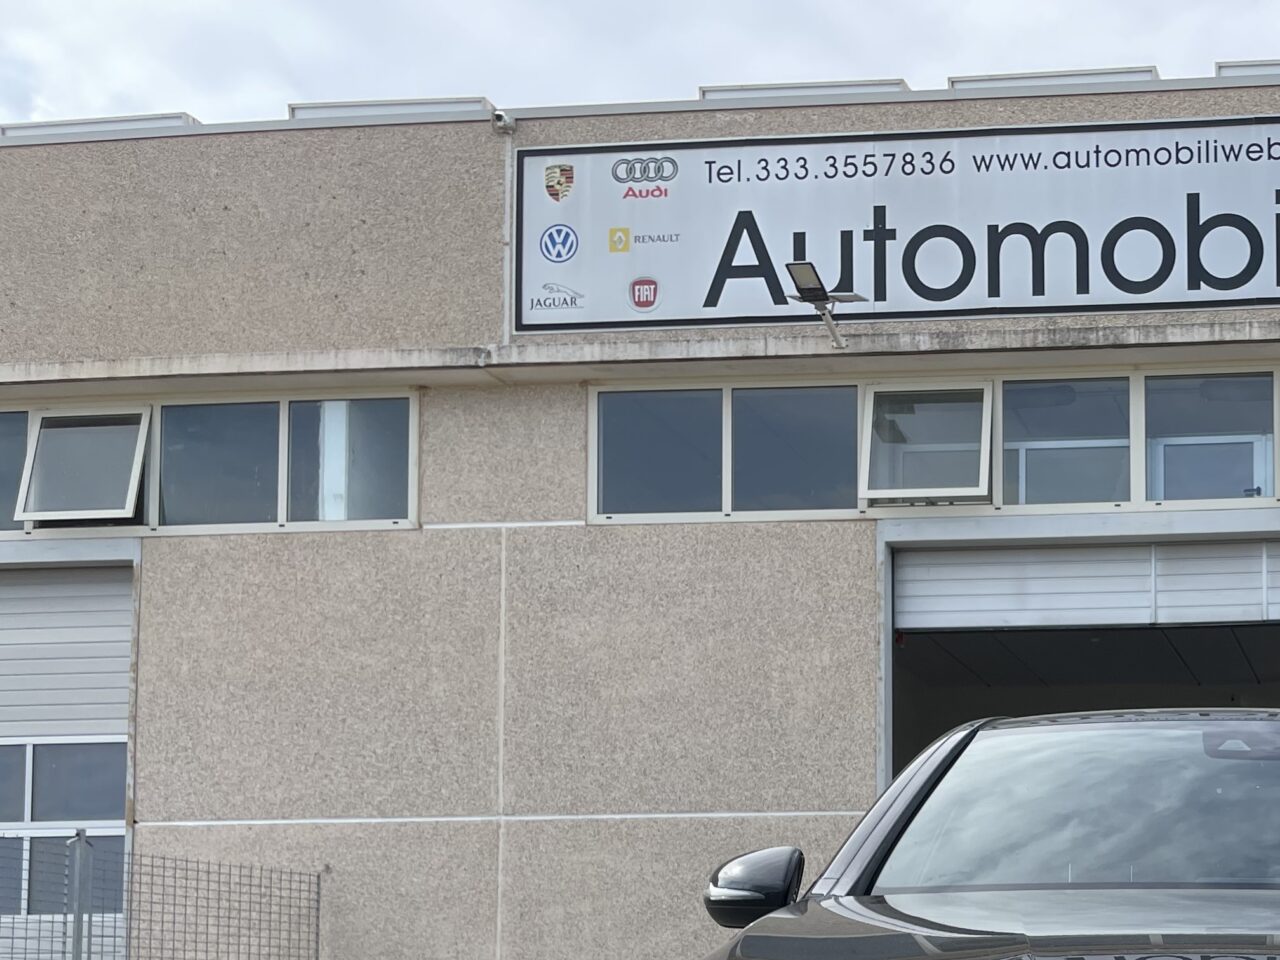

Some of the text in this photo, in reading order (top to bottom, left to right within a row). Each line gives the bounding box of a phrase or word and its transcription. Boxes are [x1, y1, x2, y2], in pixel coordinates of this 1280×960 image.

[704, 150, 956, 184] Tel.333.3557836
[622, 185, 668, 199] Audi
[633, 233, 680, 244] RENAULT
[634, 285, 656, 302] FIAT
[530, 296, 578, 310] JAGUAR
